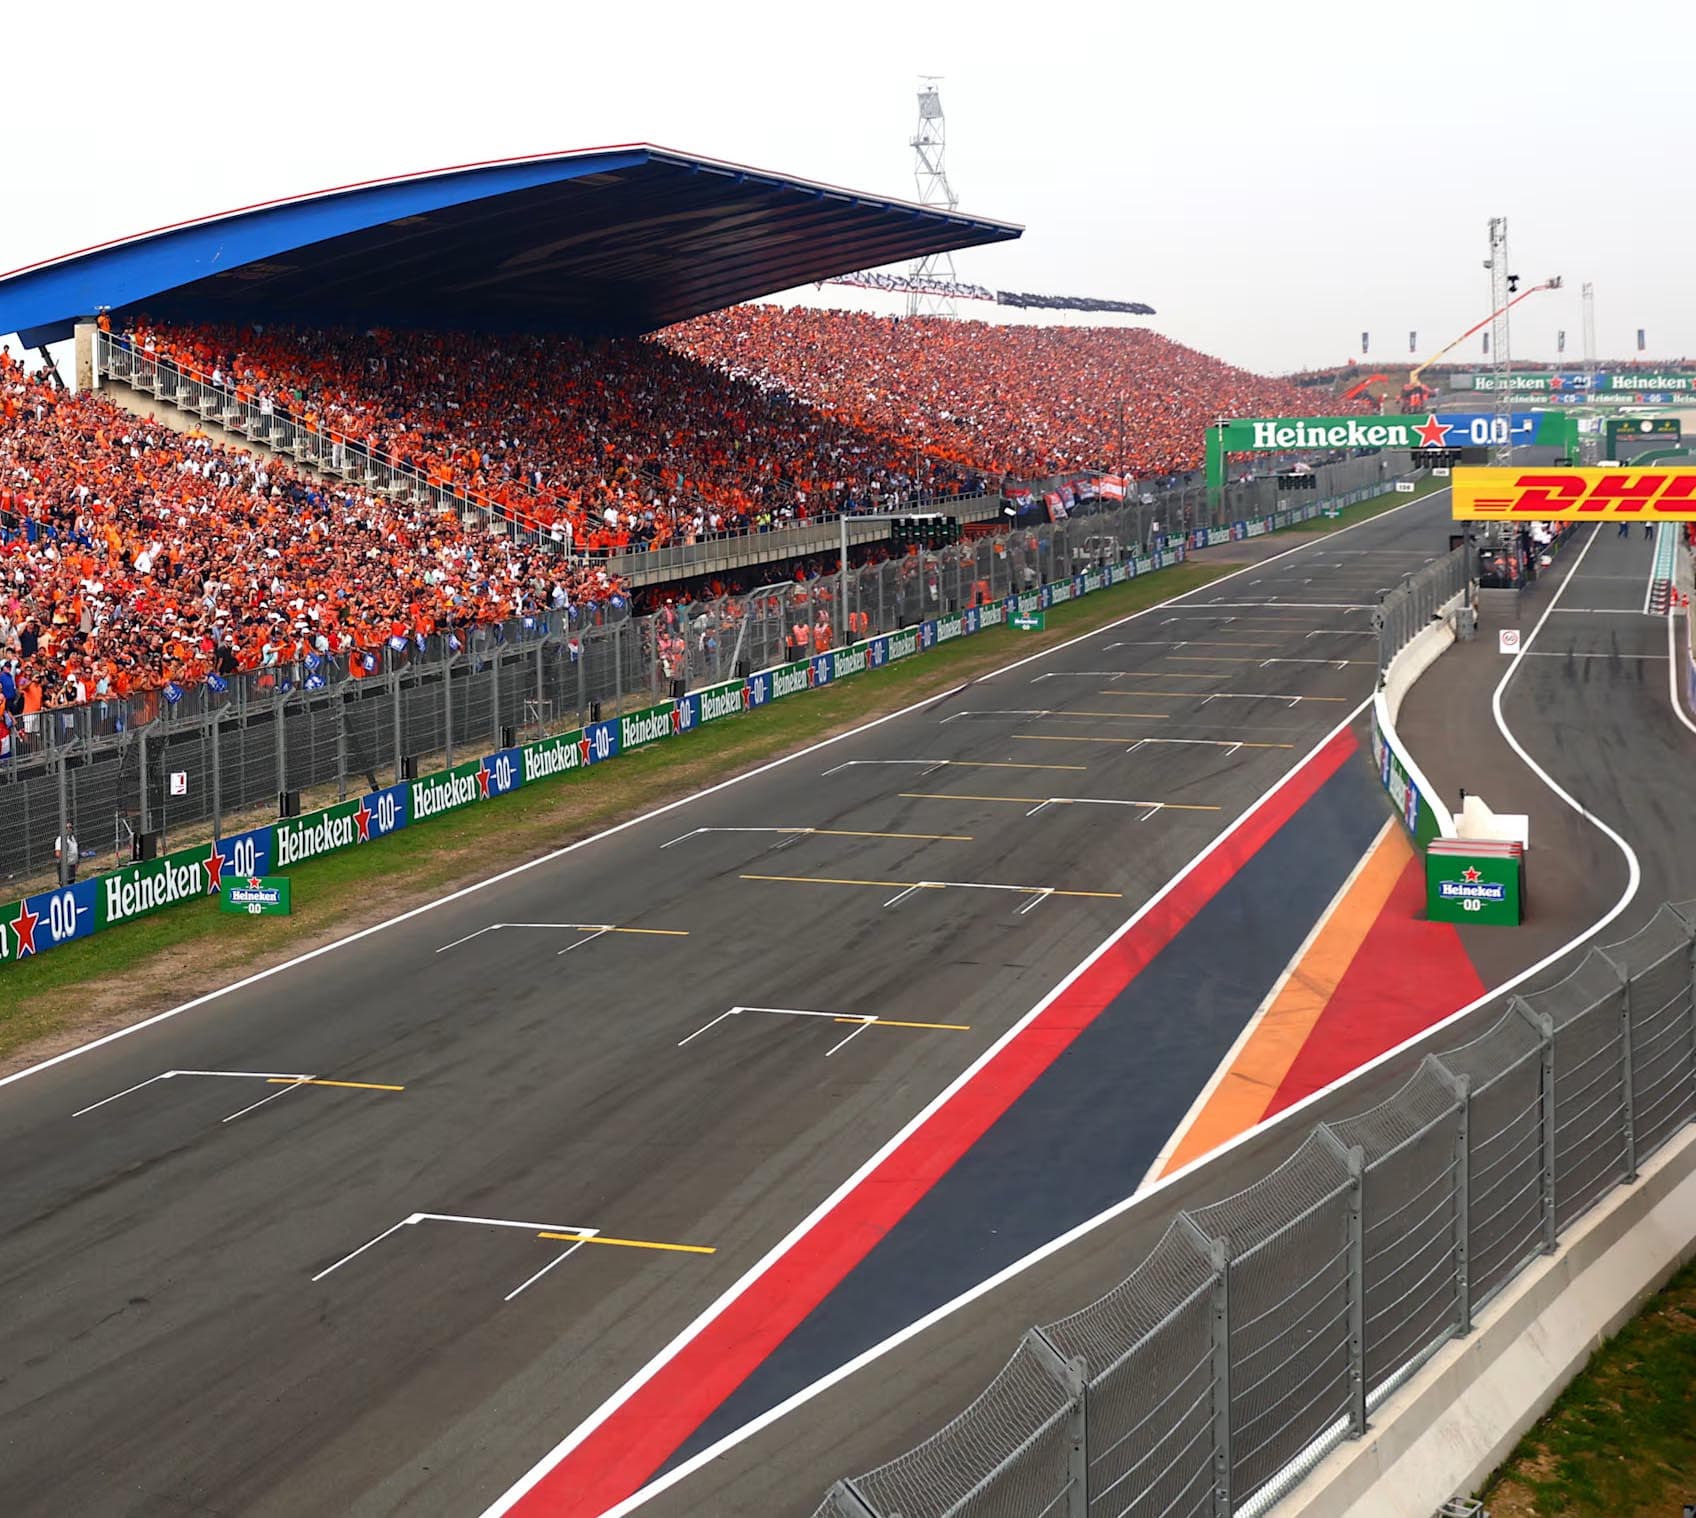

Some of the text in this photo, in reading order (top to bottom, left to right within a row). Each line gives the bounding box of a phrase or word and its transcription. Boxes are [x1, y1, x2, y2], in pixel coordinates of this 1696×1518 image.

[1612, 376, 1687, 390] Heineken
[1253, 417, 1507, 449] Heineken 0.0
[834, 651, 865, 678] Heineken
[772, 669, 807, 698] Heineken
[701, 688, 741, 721] Heineken
[622, 712, 669, 747] Heineken
[524, 744, 578, 780] Heineken
[412, 772, 477, 818] Heineken
[277, 793, 395, 865] Heineken 0.0
[105, 858, 202, 922] Heineken
[232, 889, 279, 902] Heineken
[1442, 883, 1501, 898] Heineken
[50, 892, 76, 941] 0.0
